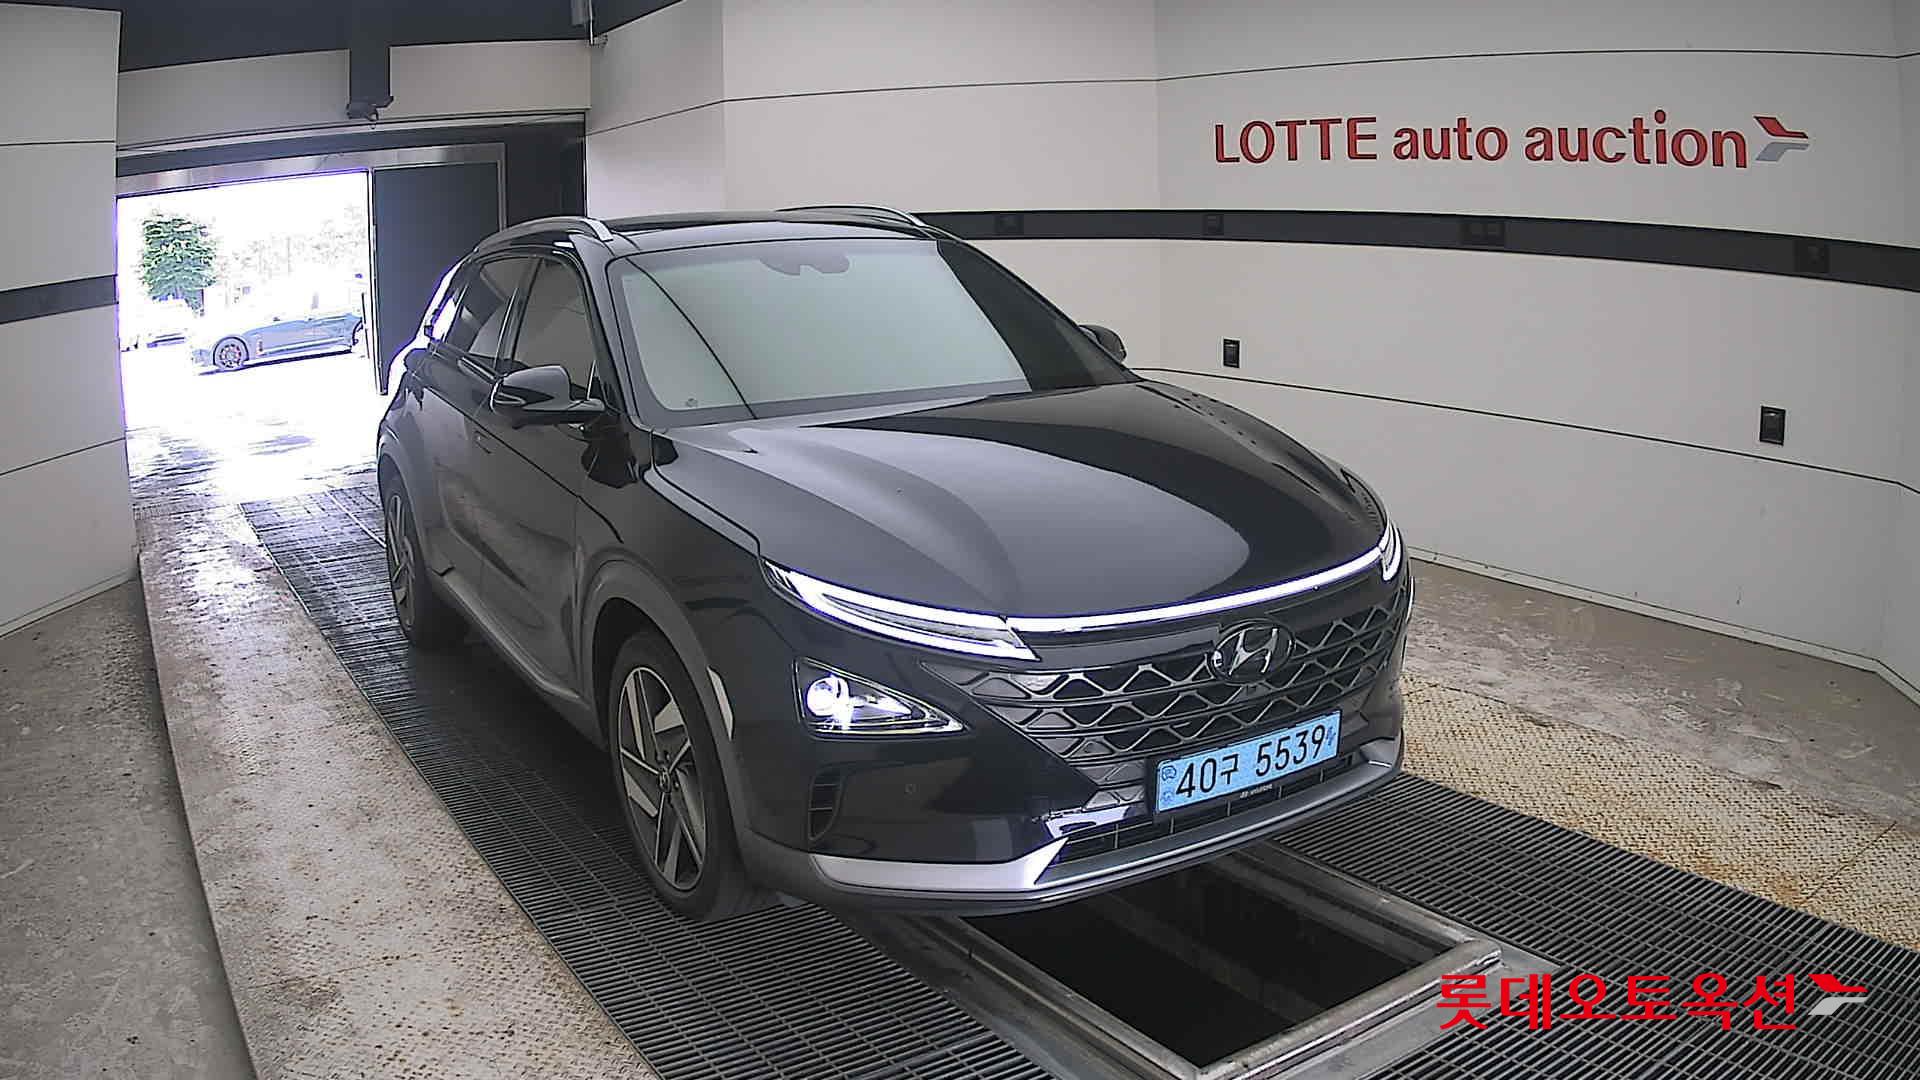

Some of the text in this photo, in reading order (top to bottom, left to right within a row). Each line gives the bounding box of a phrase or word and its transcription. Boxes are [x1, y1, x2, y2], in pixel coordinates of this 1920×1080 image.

[1214, 109, 1748, 169] LOTTE auto auction
[1175, 724, 1326, 798] 40구 5539
